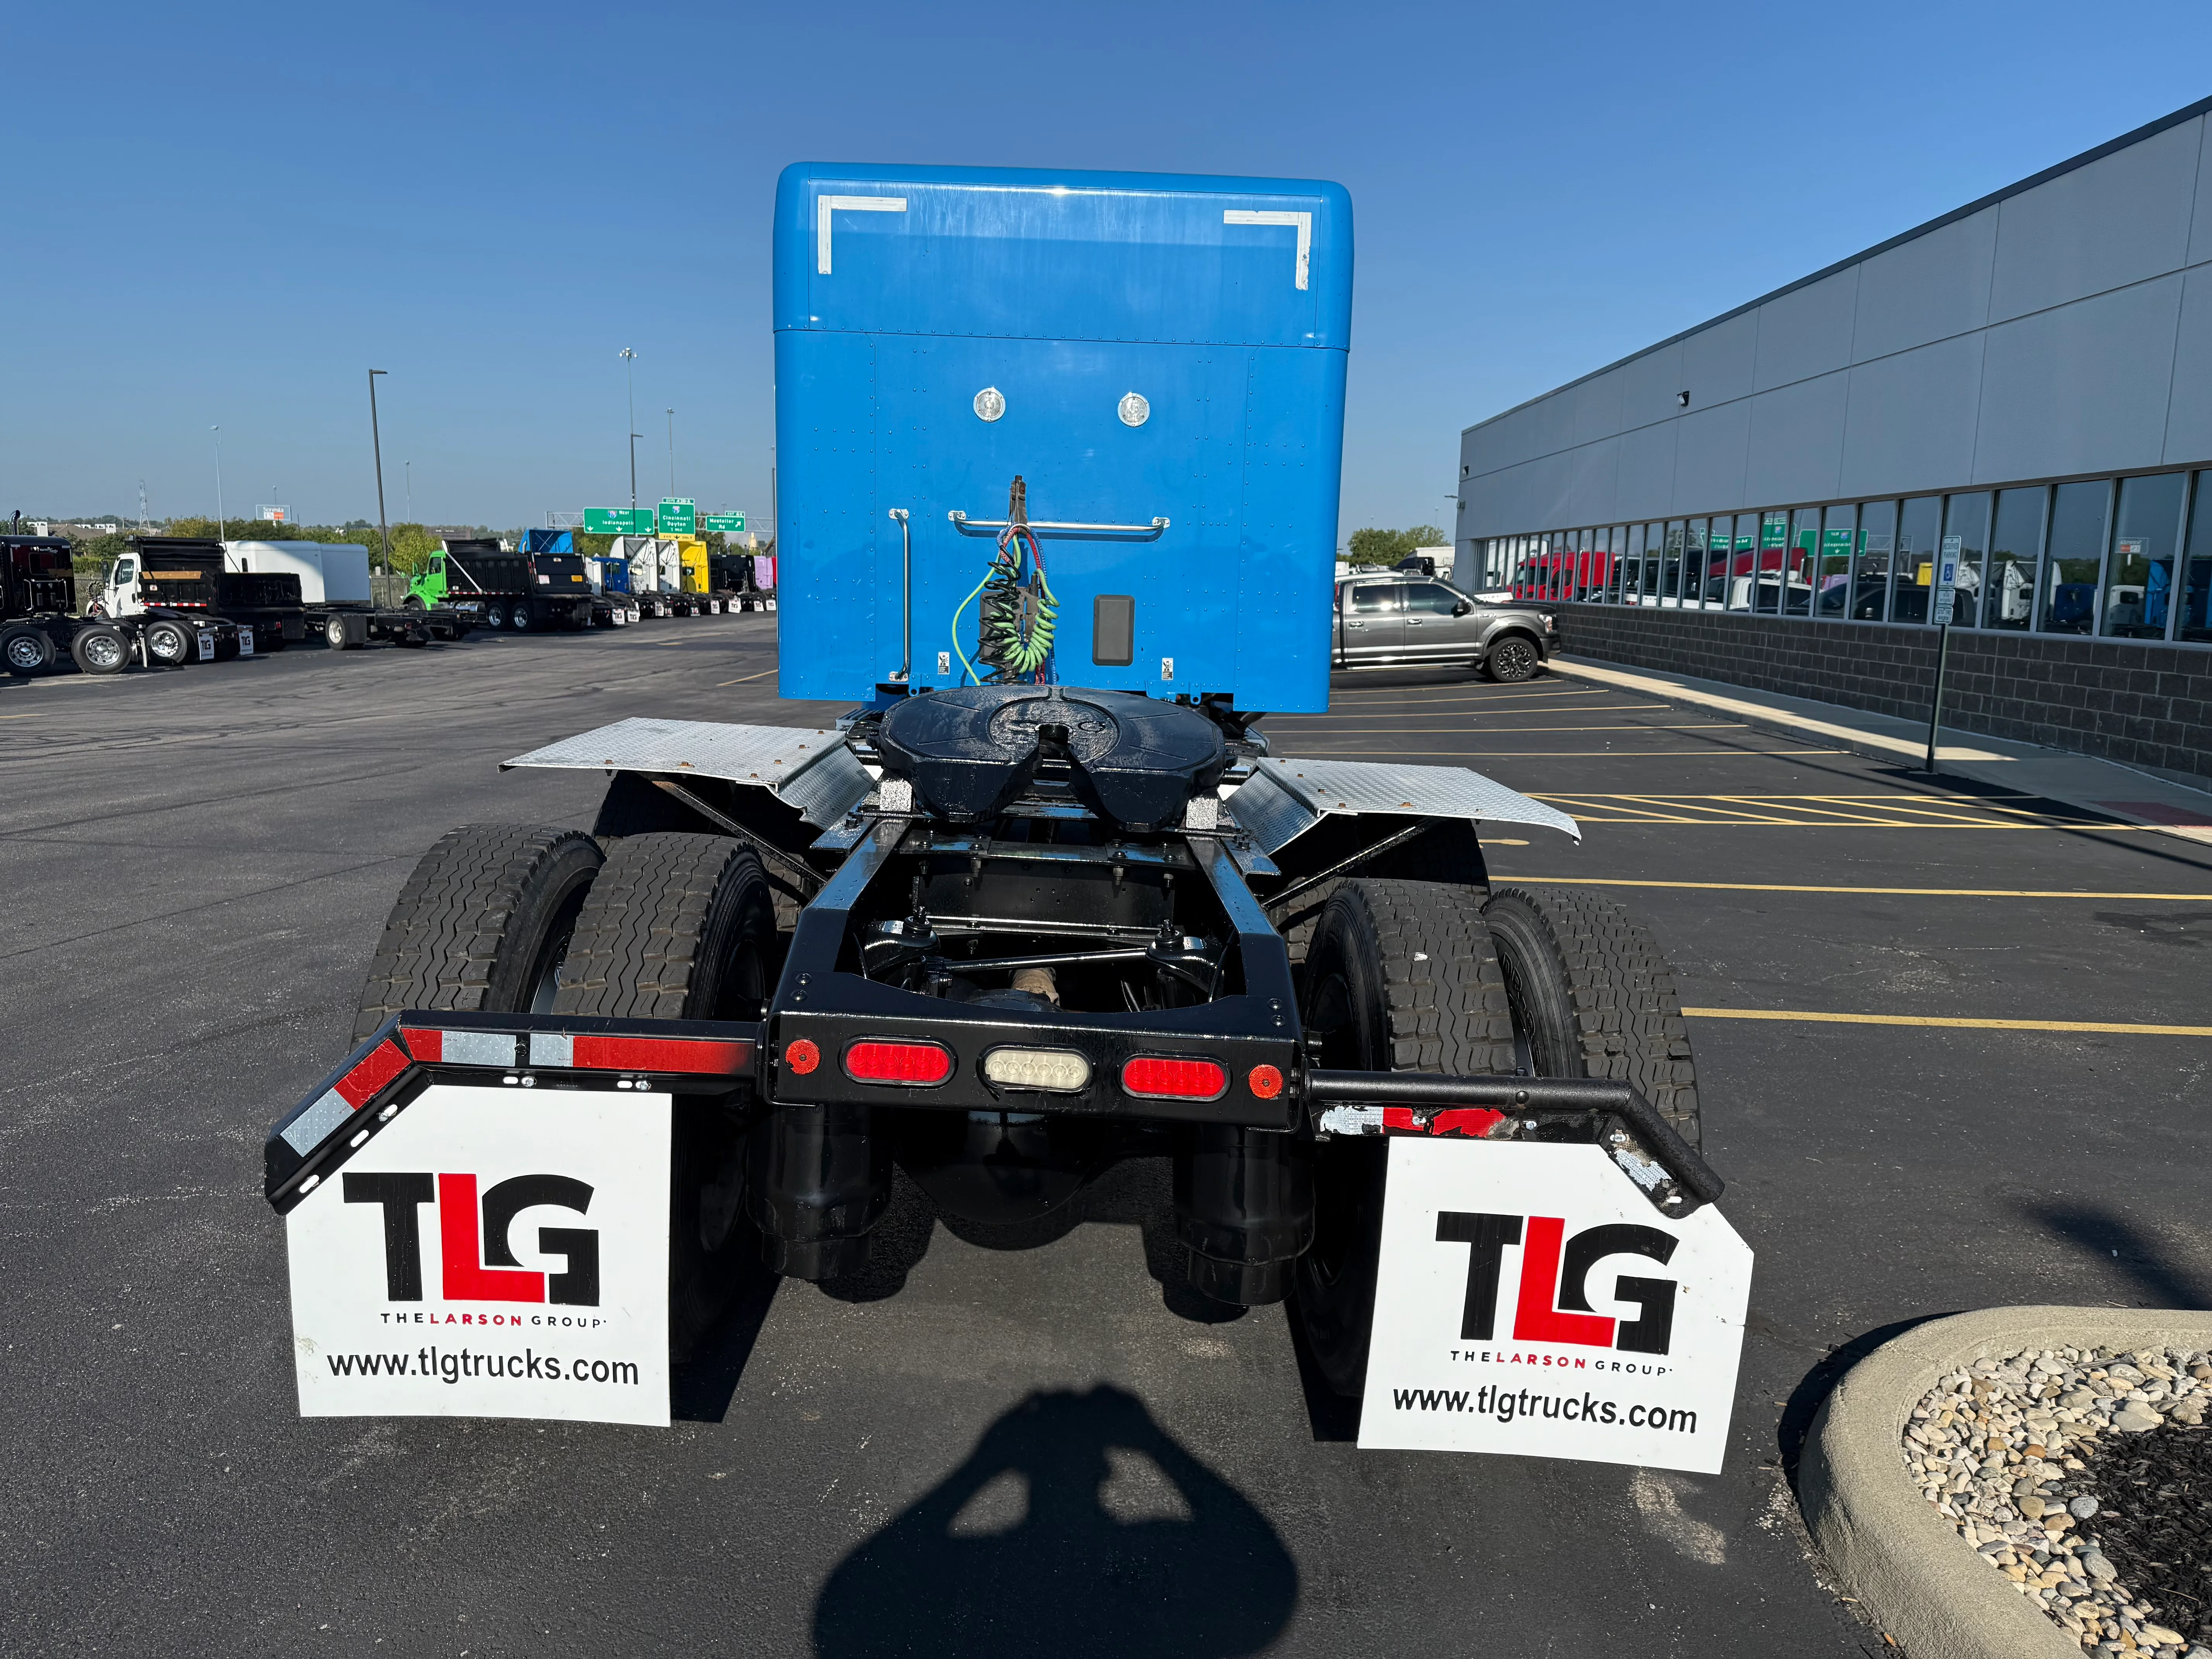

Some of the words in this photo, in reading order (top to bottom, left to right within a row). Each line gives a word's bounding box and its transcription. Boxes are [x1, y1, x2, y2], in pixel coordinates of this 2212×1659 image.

[201, 640, 211, 651] TLG
[241, 636, 251, 646] TLG
[342, 1172, 599, 1307] TLG
[1436, 1211, 1680, 1356] TLG
[327, 1346, 639, 1385] www.tlgtrucks.com
[1393, 1384, 1698, 1434] www.tlgtrucks.com
